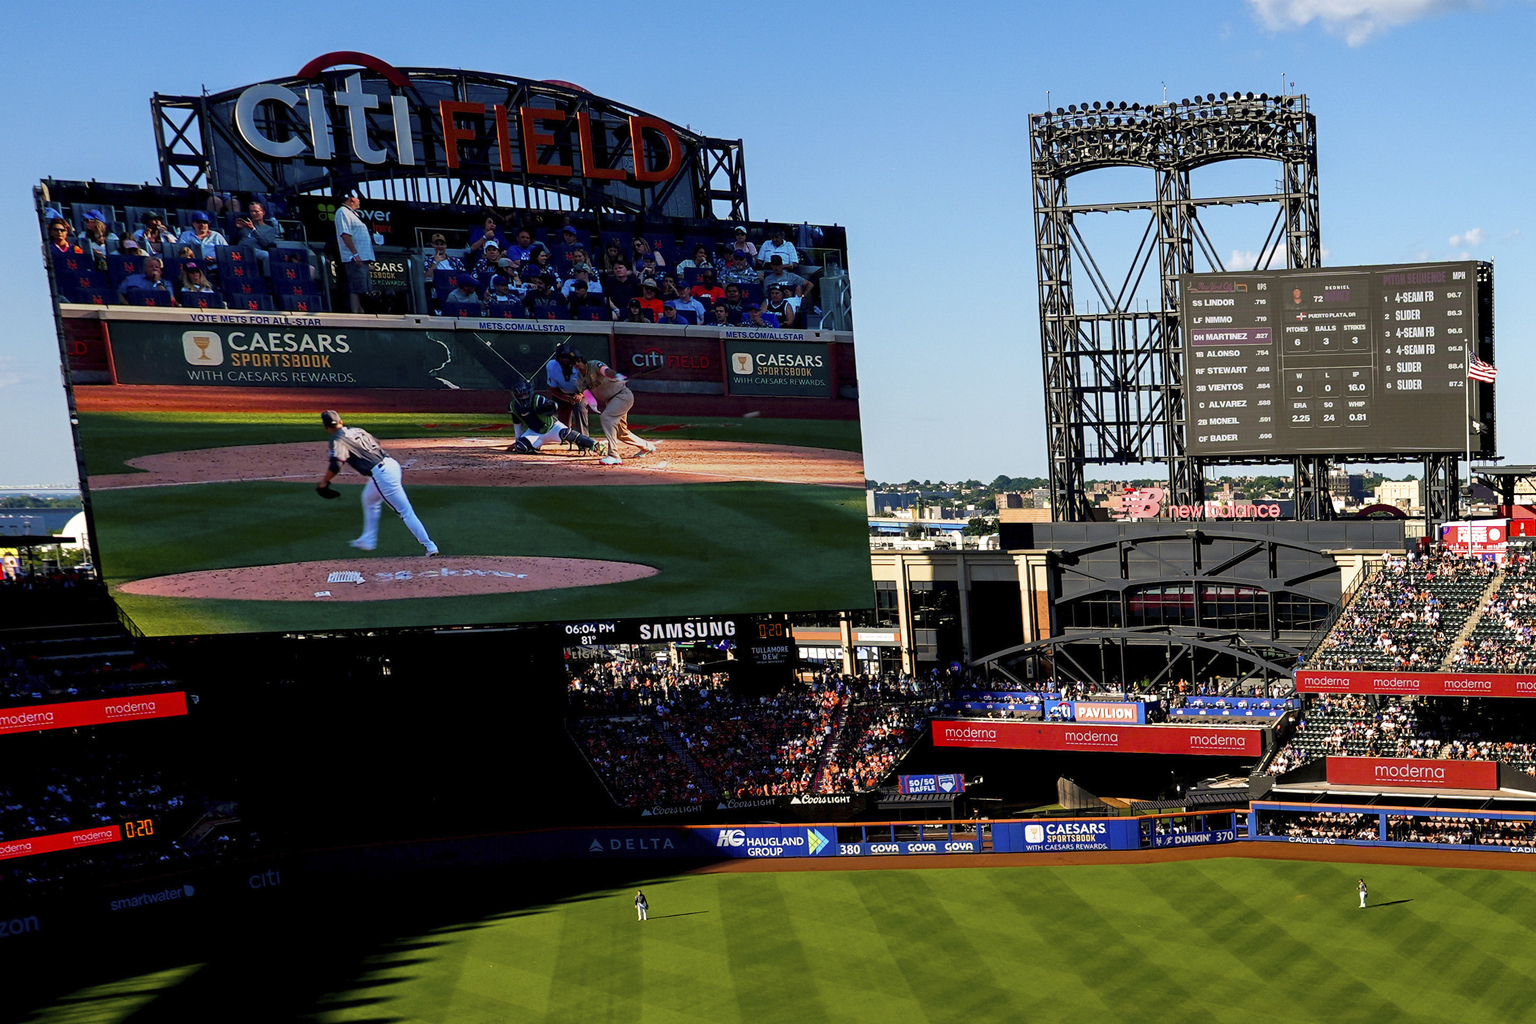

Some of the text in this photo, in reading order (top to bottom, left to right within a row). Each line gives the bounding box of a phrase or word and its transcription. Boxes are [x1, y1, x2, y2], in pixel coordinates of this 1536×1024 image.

[438, 100, 683, 183] FIELD
[1383, 271, 1446, 285] PITCH SEQUENCE
[1452, 271, 1466, 280] MPH
[1395, 291, 1434, 303] 4-SEAM FB
[190, 314, 322, 326] VOTE METS FOR ALL-STAR
[1395, 309, 1421, 321] SLIDER
[479, 321, 566, 332] METS.COM/ALLSTAR
[1396, 327, 1424, 338] 4-SEAM
[1425, 326, 1435, 337] FB
[725, 330, 804, 341] METS.COM/ALLSTAR
[1323, 337, 1330, 345] 3
[1352, 336, 1358, 344] 3
[1294, 338, 1301, 346] 6
[1396, 344, 1436, 355] 4-SEAM FB
[231, 353, 331, 368] SPORTSBOOK
[667, 355, 709, 369] FIELD
[757, 366, 812, 376] SPORTSBOOK
[1207, 366, 1248, 374] STEWART
[1396, 362, 1422, 373] SLIDER
[187, 370, 357, 383] WITH CAESARS REWARDS.
[755, 377, 788, 385] CAESARS
[1207, 383, 1244, 391] VIENTOS
[1348, 383, 1366, 391] 16.0
[1397, 379, 1422, 390] SLIDER
[1208, 400, 1247, 408] ALVAREZ
[1209, 417, 1240, 425] MCNEIL
[1292, 414, 1310, 422] 2.25
[1323, 414, 1335, 422] 24
[1349, 413, 1367, 421] 0.81
[1210, 434, 1238, 442] BADER
[1168, 501, 1281, 518] new balance
[565, 623, 615, 635] 06:04 PM
[640, 621, 736, 640] SAMSUNG
[759, 623, 782, 637] 0:20
[581, 635, 597, 645] 81°
[751, 646, 789, 654] TULLAMORE
[1444, 678, 1492, 690] moderna
[1078, 707, 1134, 719] PAVILION
[945, 726, 996, 739] moderna
[1065, 730, 1118, 743] moderna
[1190, 733, 1246, 747] moderna
[1374, 763, 1445, 780] moderna
[909, 777, 935, 787] 50/50
[910, 784, 936, 793] RAFFLE
[727, 798, 776, 811] Coors LIGHT
[800, 793, 850, 805] Coors LIGHT
[650, 805, 703, 817] Coors LIGHT
[125, 819, 154, 839] 0:20
[1045, 822, 1106, 836] CAESARS
[746, 836, 804, 847] HAUGLAND
[1047, 833, 1097, 843] SPORTSBOOK
[1174, 832, 1212, 844] DUNKIN'
[1215, 830, 1234, 842] 370
[1288, 836, 1336, 845] CADILLAC
[610, 837, 674, 850] DELTA
[840, 843, 861, 855] 380
[871, 843, 899, 853] GOYA
[907, 843, 936, 853] GOYA
[944, 842, 974, 852] GOYA
[747, 847, 783, 856] GROUP
[248, 868, 281, 889] citi
[110, 886, 183, 912] smartwater
